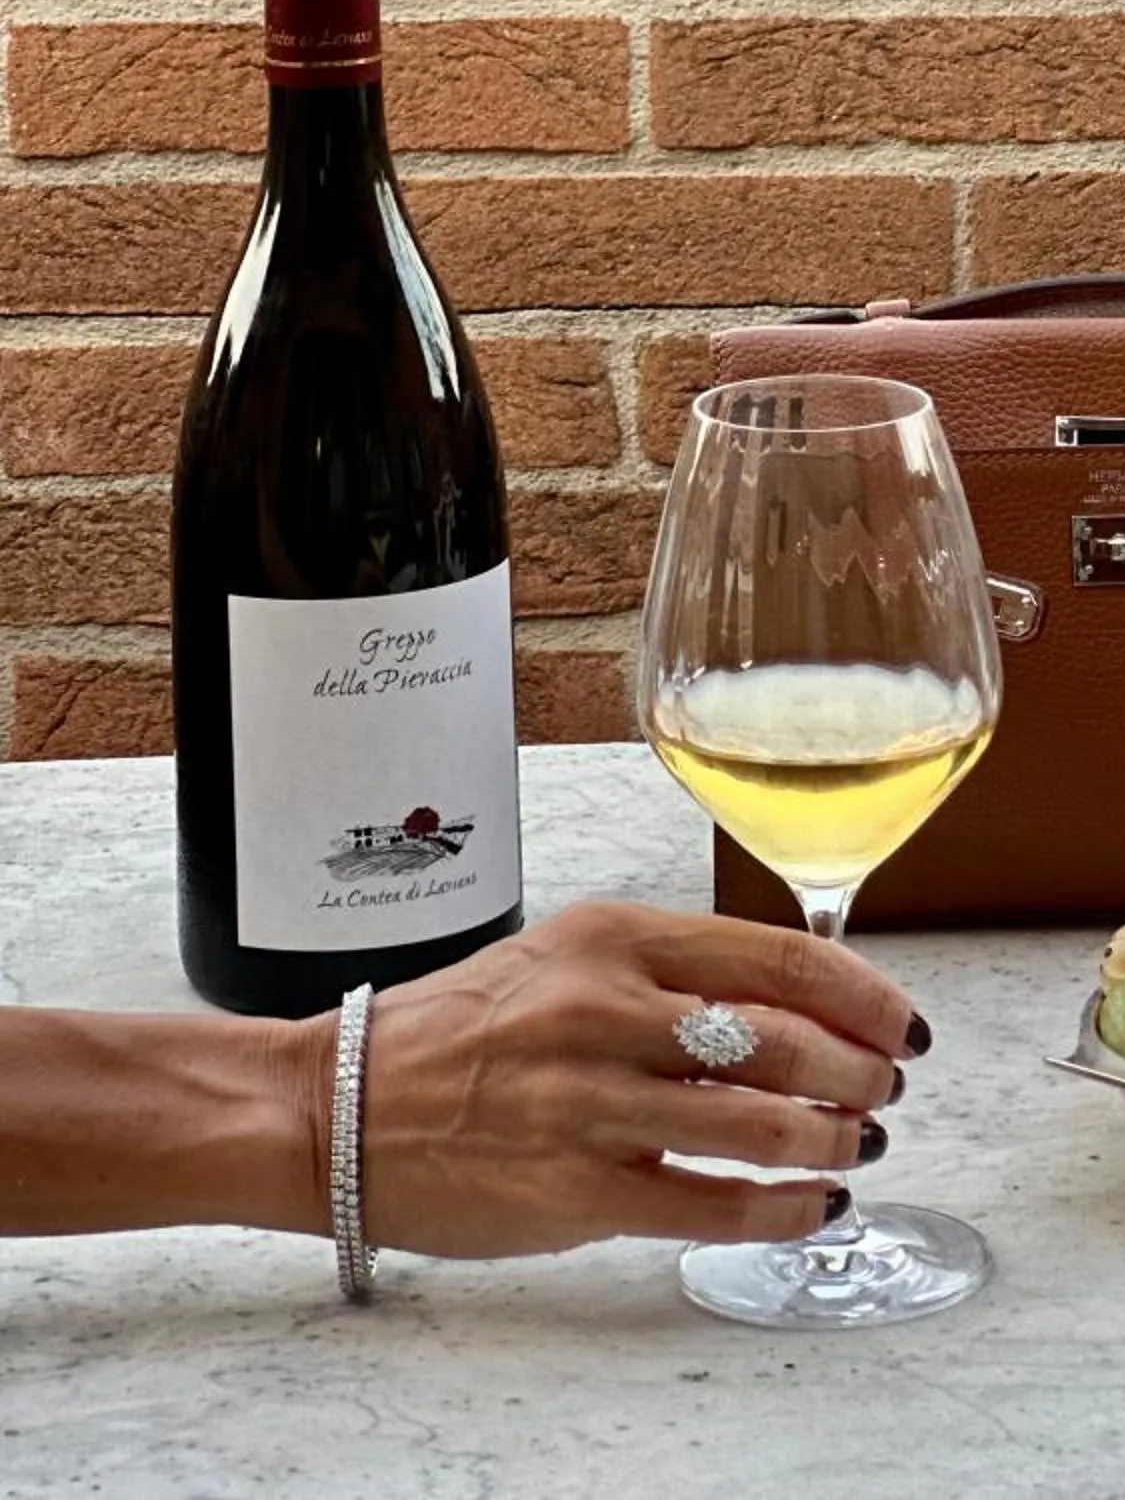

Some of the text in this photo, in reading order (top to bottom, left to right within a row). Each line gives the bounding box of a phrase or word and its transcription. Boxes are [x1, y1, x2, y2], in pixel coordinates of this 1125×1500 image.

[313, 667, 368, 697] della
[317, 890, 342, 908] La
[405, 881, 421, 901] di
